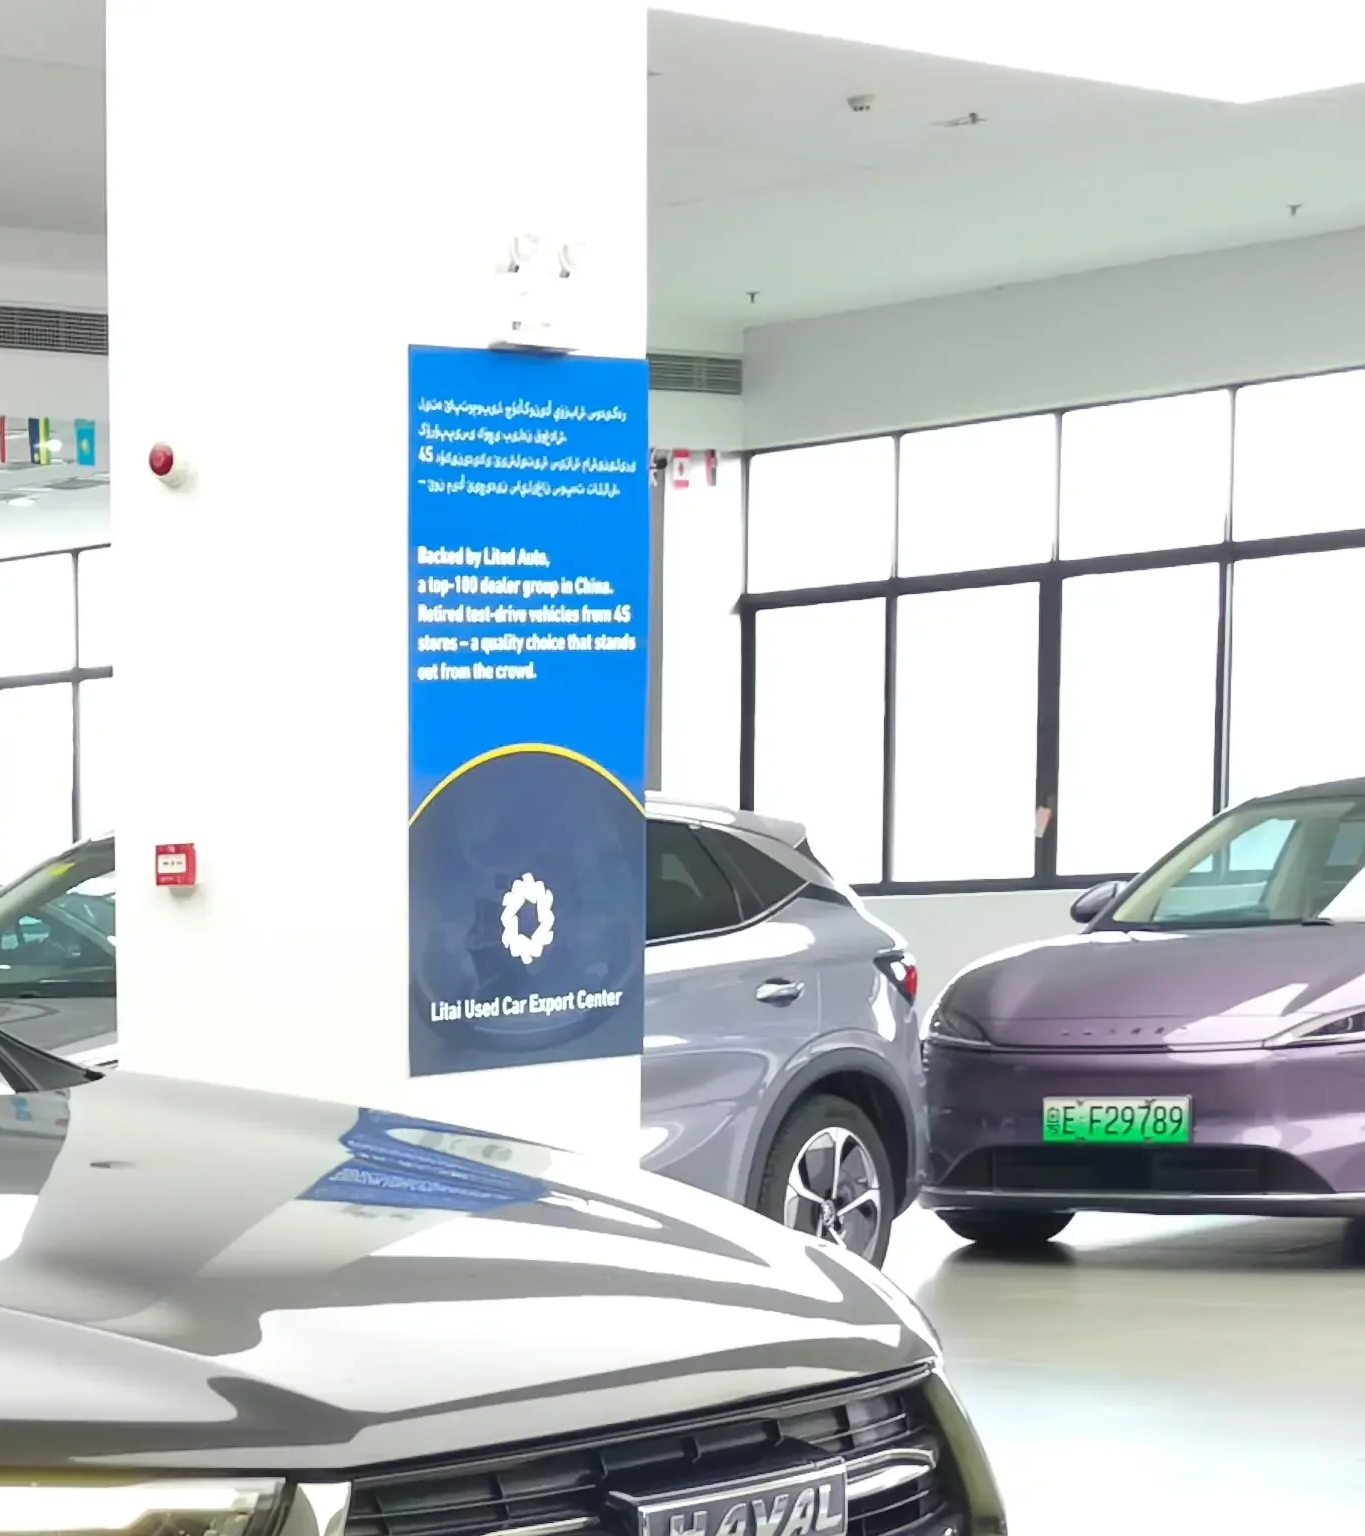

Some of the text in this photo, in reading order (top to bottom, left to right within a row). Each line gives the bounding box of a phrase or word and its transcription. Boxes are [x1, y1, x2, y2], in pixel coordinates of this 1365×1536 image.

[417, 546, 464, 565] Backed
[465, 547, 482, 568] by
[417, 575, 614, 598] a top-100 dealer group in China.
[417, 604, 464, 622] Retired
[465, 604, 527, 622] test-drive
[528, 604, 580, 622] vehicles
[581, 604, 612, 622] from
[417, 635, 458, 651] stores
[470, 637, 479, 651] a
[480, 634, 524, 654] quality
[525, 633, 566, 650] choice
[567, 633, 593, 650] that
[594, 633, 636, 650] stands
[417, 661, 537, 680] out from the crowd.
[431, 989, 623, 1022] Litai Used Car Export Center
[1089, 1106, 1184, 1136] F29789
